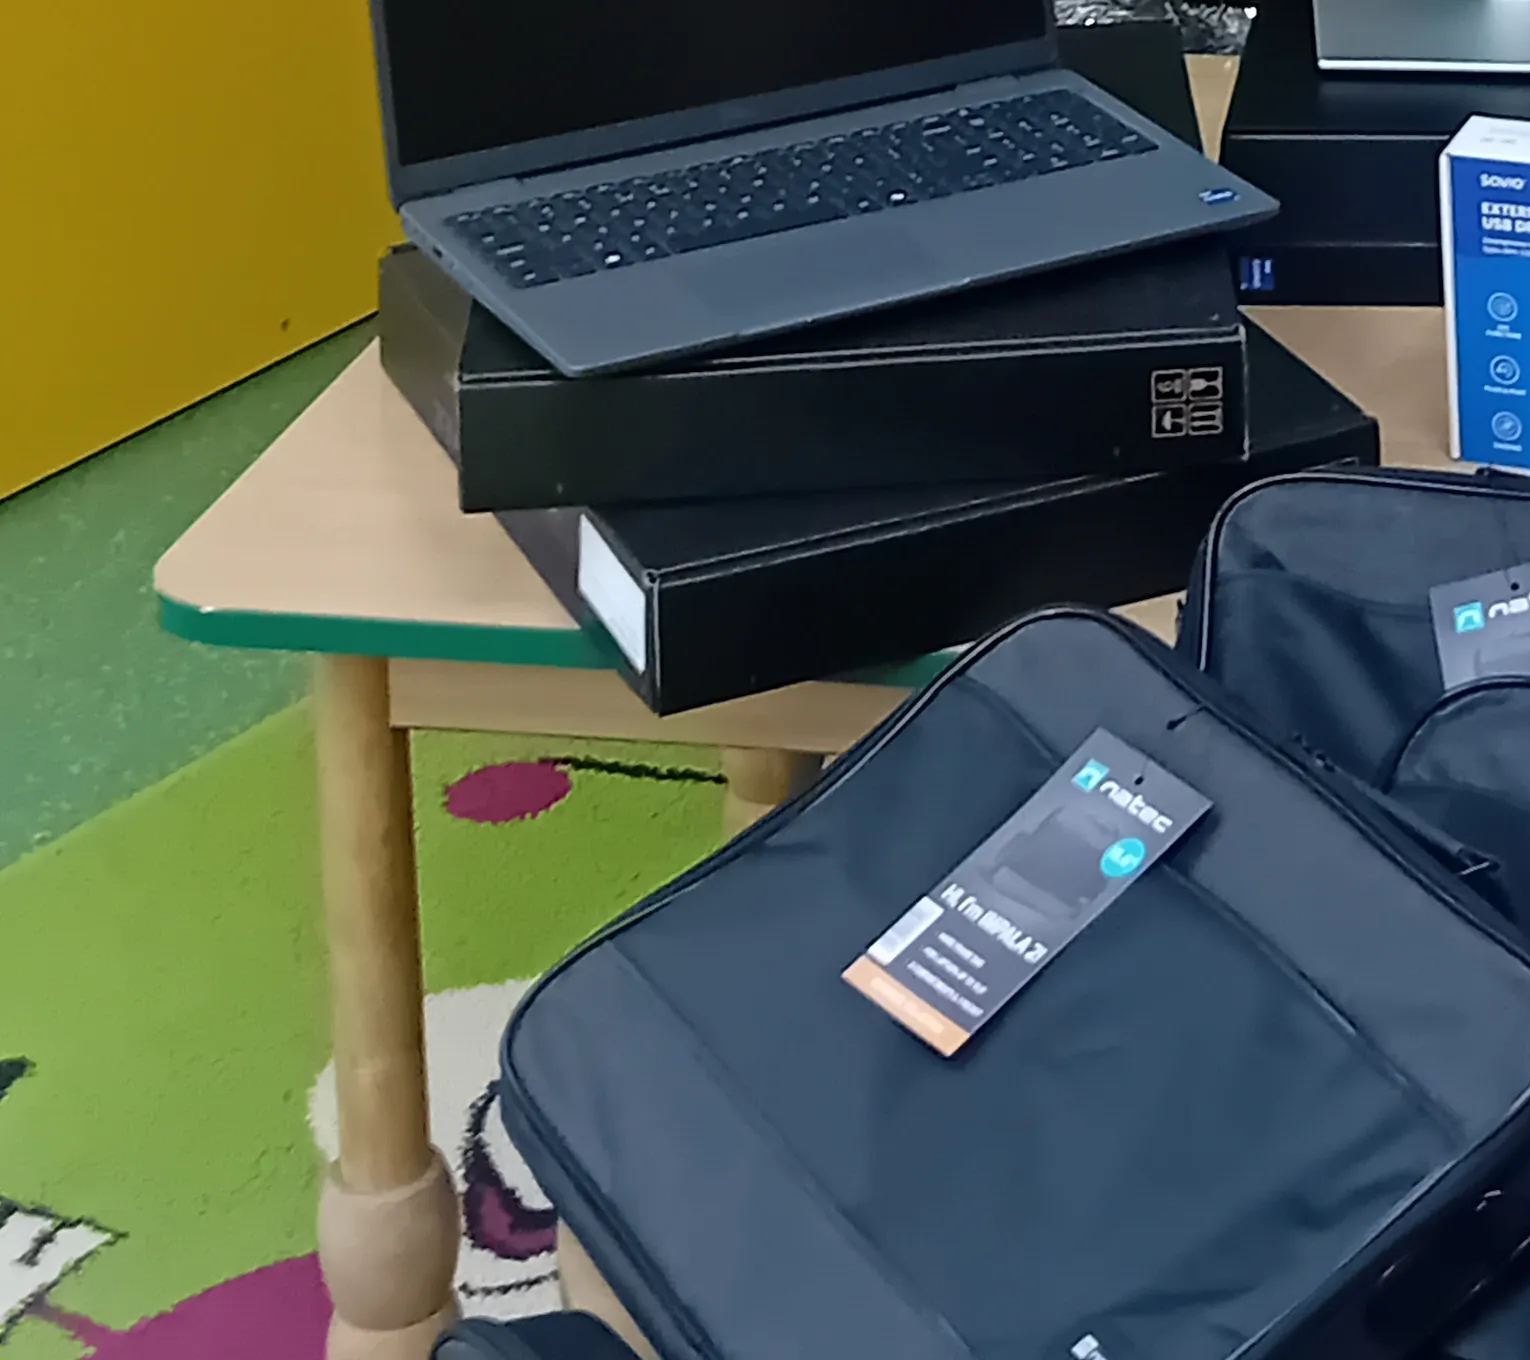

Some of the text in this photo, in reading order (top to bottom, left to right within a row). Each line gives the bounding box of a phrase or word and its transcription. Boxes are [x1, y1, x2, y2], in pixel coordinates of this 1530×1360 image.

[1481, 216, 1512, 233] USB
[1099, 780, 1174, 834] natec
[977, 909, 1033, 956] IMPALA
